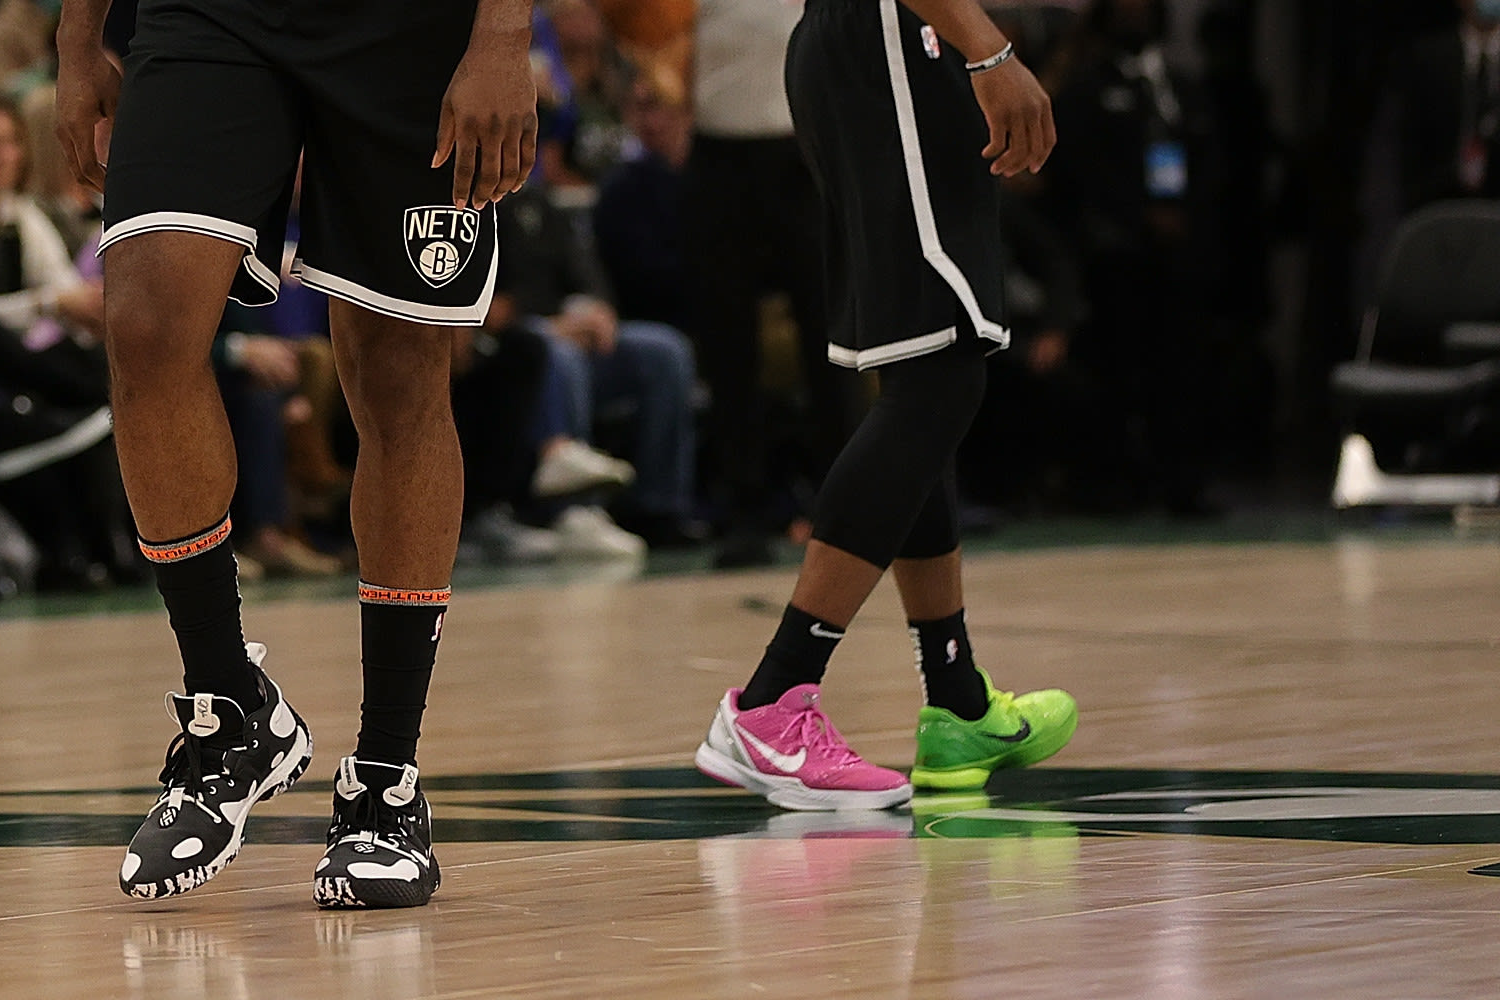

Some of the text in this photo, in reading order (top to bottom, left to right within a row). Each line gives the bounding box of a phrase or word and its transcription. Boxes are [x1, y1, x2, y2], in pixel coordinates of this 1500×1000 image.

[408, 210, 475, 243] NETS
[432, 246, 447, 275] B
[359, 588, 434, 601] AUTHEN
